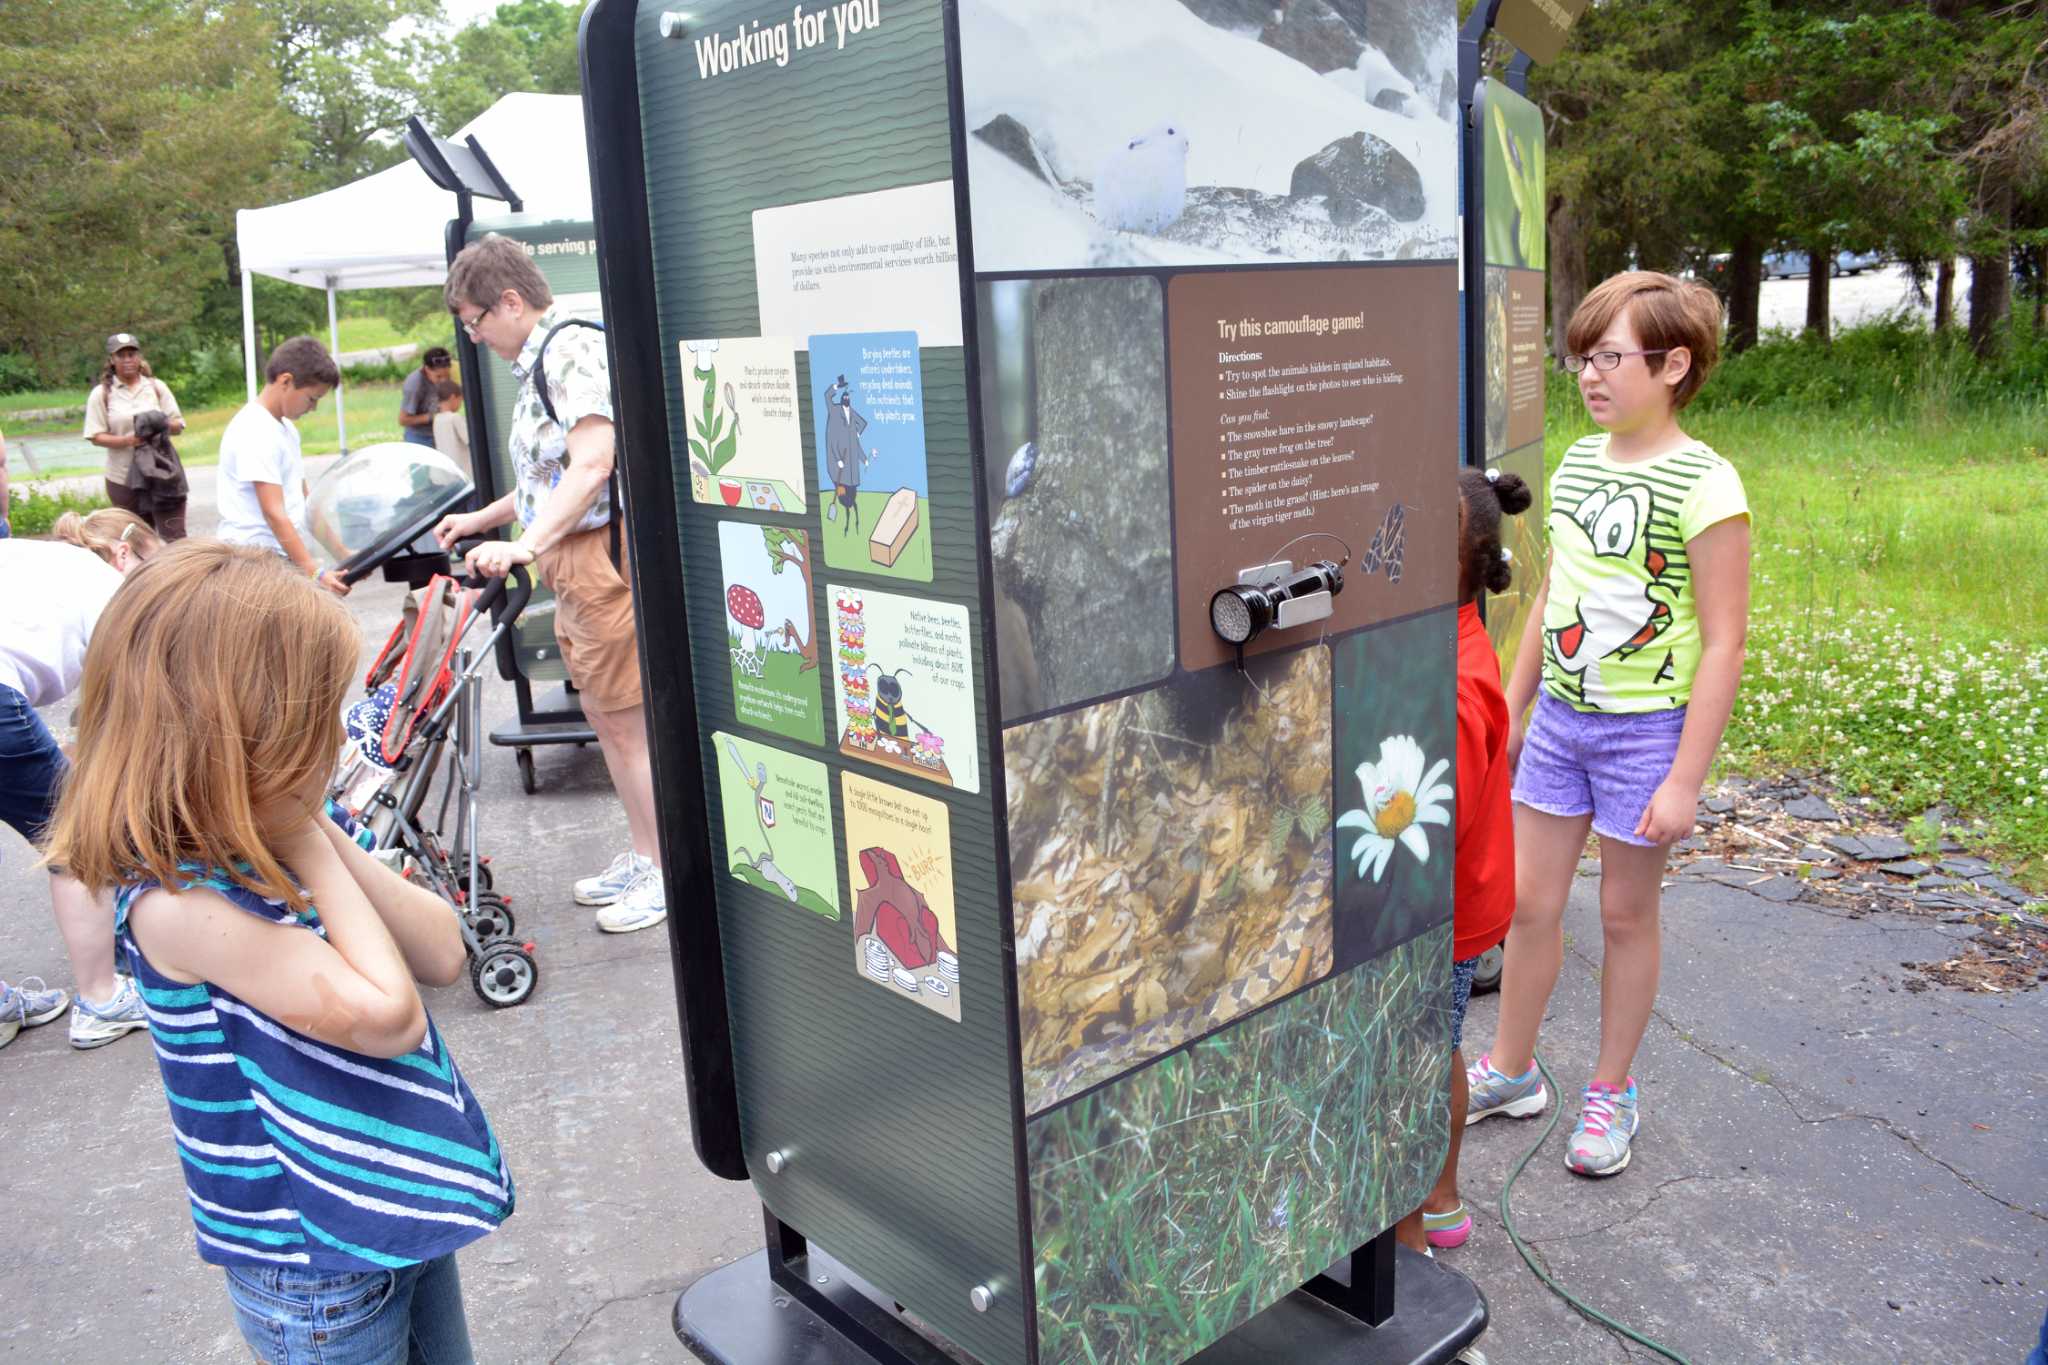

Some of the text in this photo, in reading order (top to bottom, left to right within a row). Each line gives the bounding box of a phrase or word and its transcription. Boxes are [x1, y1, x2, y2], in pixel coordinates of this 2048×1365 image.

[694, 0, 880, 80] Working for you
[537, 237, 586, 256] serving
[1217, 311, 1365, 342] Try this camouflage game!
[1218, 350, 1263, 364] Directions:
[1225, 370, 1240, 383] Try
[1241, 369, 1250, 380] to
[1250, 368, 1266, 381] spot
[1268, 366, 1281, 377] the
[1281, 364, 1309, 376] animals
[1310, 361, 1333, 373] hidden
[1333, 360, 1341, 371] in
[1226, 388, 1248, 401] Shine
[1249, 387, 1261, 398] the
[1262, 383, 1295, 397] flashlight
[1296, 384, 1305, 393] on
[1305, 380, 1318, 392] the
[1318, 378, 1341, 392] photos
[1341, 377, 1349, 388] to
[1350, 377, 1361, 388] see
[1361, 375, 1376, 386] who
[1376, 374, 1383, 385] is
[1220, 414, 1237, 425] Can
[1238, 414, 1252, 426] you
[1227, 431, 1242, 443] The
[1243, 427, 1278, 441] snowshoe
[1279, 425, 1295, 436] hare
[1295, 424, 1304, 434] in
[1304, 422, 1317, 433] the
[1317, 419, 1338, 431] snowy
[1228, 449, 1243, 461] The
[1243, 448, 1261, 462] gray
[1262, 445, 1278, 457] tree
[1279, 443, 1294, 455] frog
[1294, 442, 1304, 452] on
[1304, 439, 1317, 450] the
[1228, 468, 1243, 480] The
[1244, 464, 1270, 477] timber
[1270, 458, 1309, 473] rattlesnake
[1310, 457, 1320, 466] on
[1319, 454, 1332, 465] the
[1228, 486, 1244, 497] The
[1244, 482, 1268, 497] spider
[1268, 480, 1278, 490] on
[1278, 478, 1290, 489] the
[1229, 503, 1244, 516] The
[1245, 500, 1264, 513] moth
[1265, 499, 1274, 509] in
[1273, 496, 1286, 508] the
[1350, 485, 1360, 494] an
[1360, 481, 1380, 495] image
[1230, 519, 1239, 531] of
[1239, 517, 1251, 529] the
[1252, 512, 1274, 527] virgin
[1275, 509, 1293, 523] tiger
